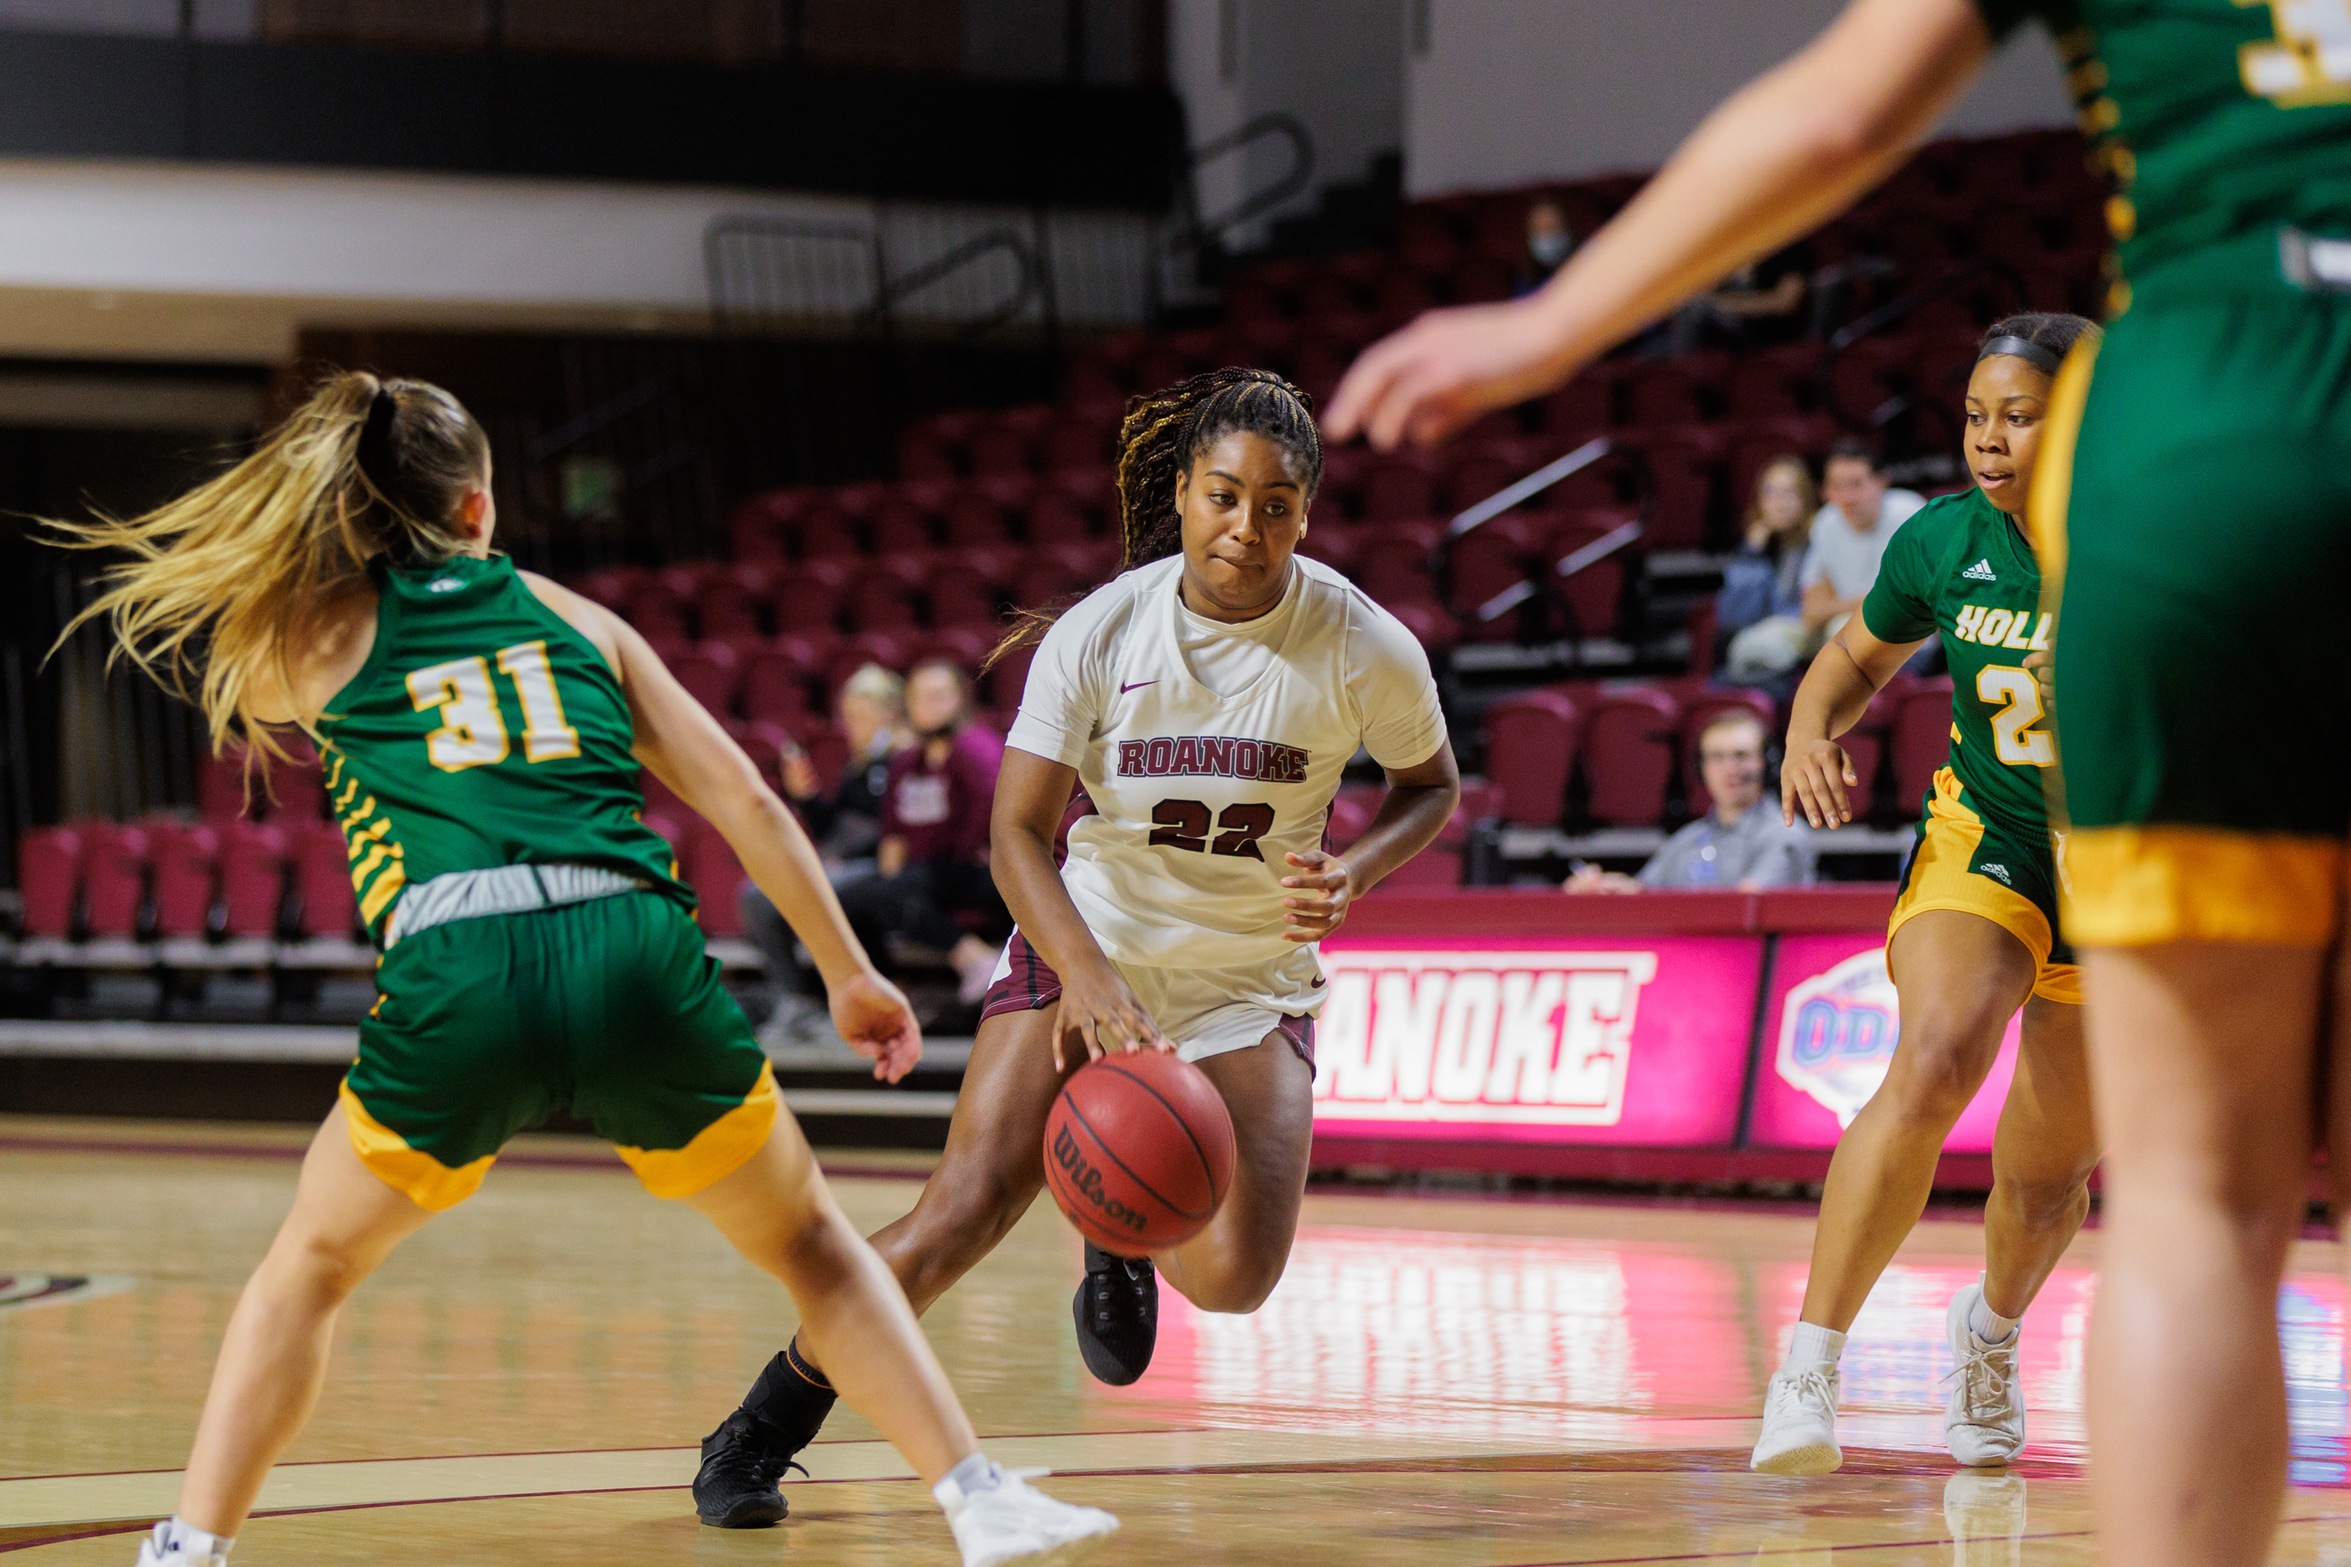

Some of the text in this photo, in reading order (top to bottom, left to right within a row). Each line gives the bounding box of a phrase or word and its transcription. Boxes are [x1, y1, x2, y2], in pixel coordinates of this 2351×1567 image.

[1962, 570, 1997, 581] adidas
[404, 639, 582, 773] 31
[1976, 664, 2058, 768] 2
[1117, 736, 1310, 783] ROANOKE
[1149, 798, 1276, 863] 22
[1980, 864, 2012, 885] adidas
[1793, 998, 1900, 1066] OD
[1053, 1120, 1148, 1232] Wilson
